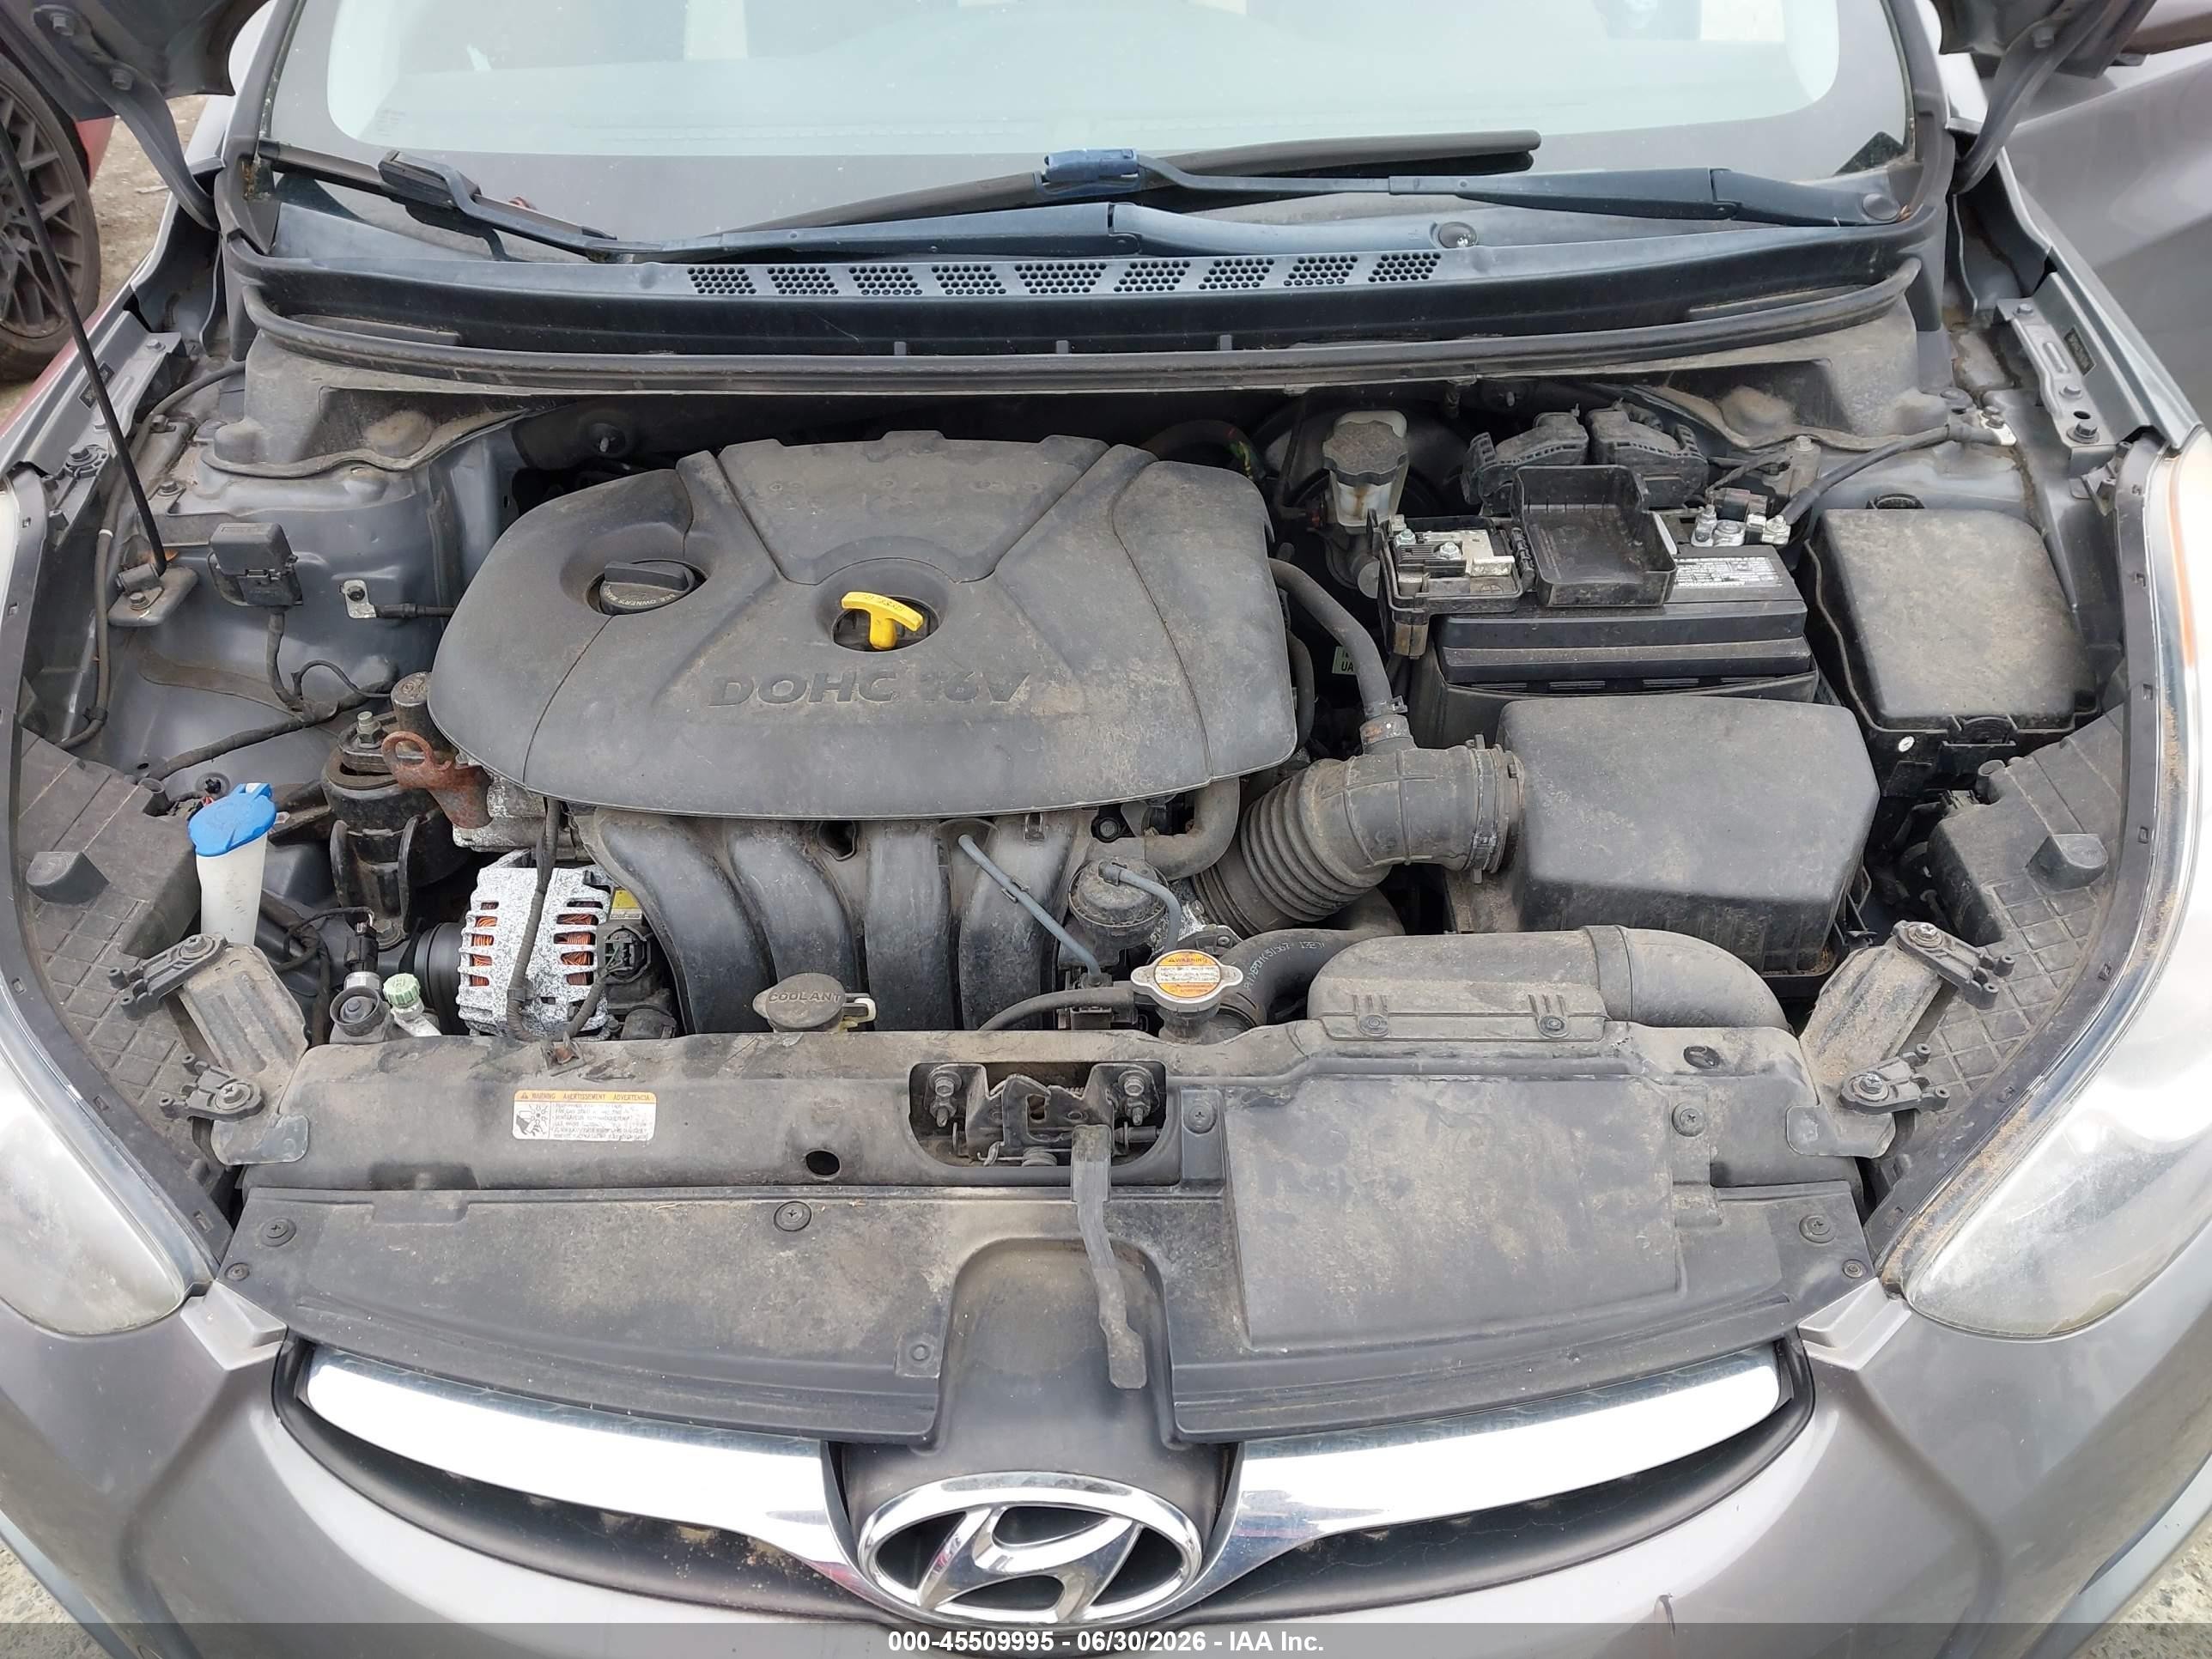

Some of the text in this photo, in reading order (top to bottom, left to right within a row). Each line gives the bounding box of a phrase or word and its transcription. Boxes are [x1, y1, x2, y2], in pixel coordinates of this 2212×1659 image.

[659, 593, 676, 602] SEE
[708, 671, 1030, 707] DOHC 16V
[769, 991, 842, 1004] COOLANT
